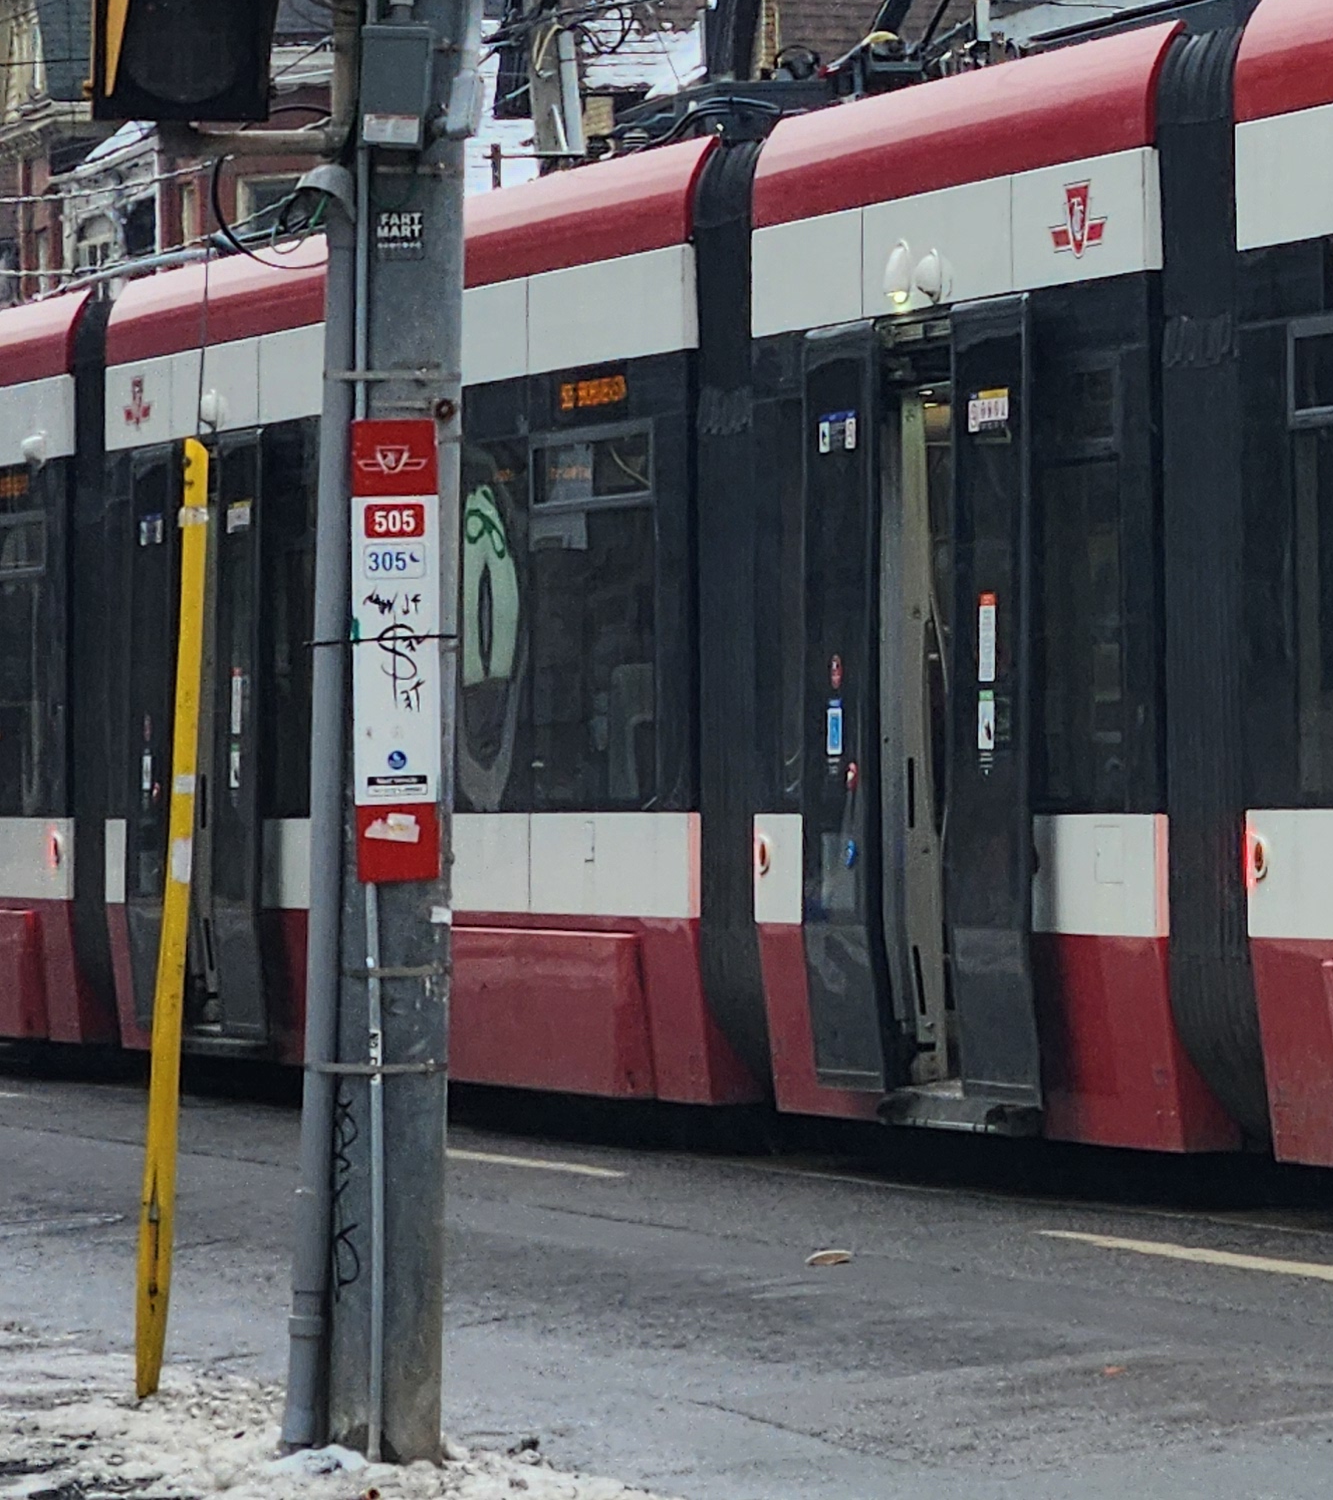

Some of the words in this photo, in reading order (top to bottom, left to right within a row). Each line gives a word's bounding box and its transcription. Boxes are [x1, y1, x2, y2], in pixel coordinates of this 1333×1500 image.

[380, 212, 422, 226] FART
[376, 225, 422, 238] MART
[374, 510, 416, 533] 505
[368, 551, 407, 572] 305
